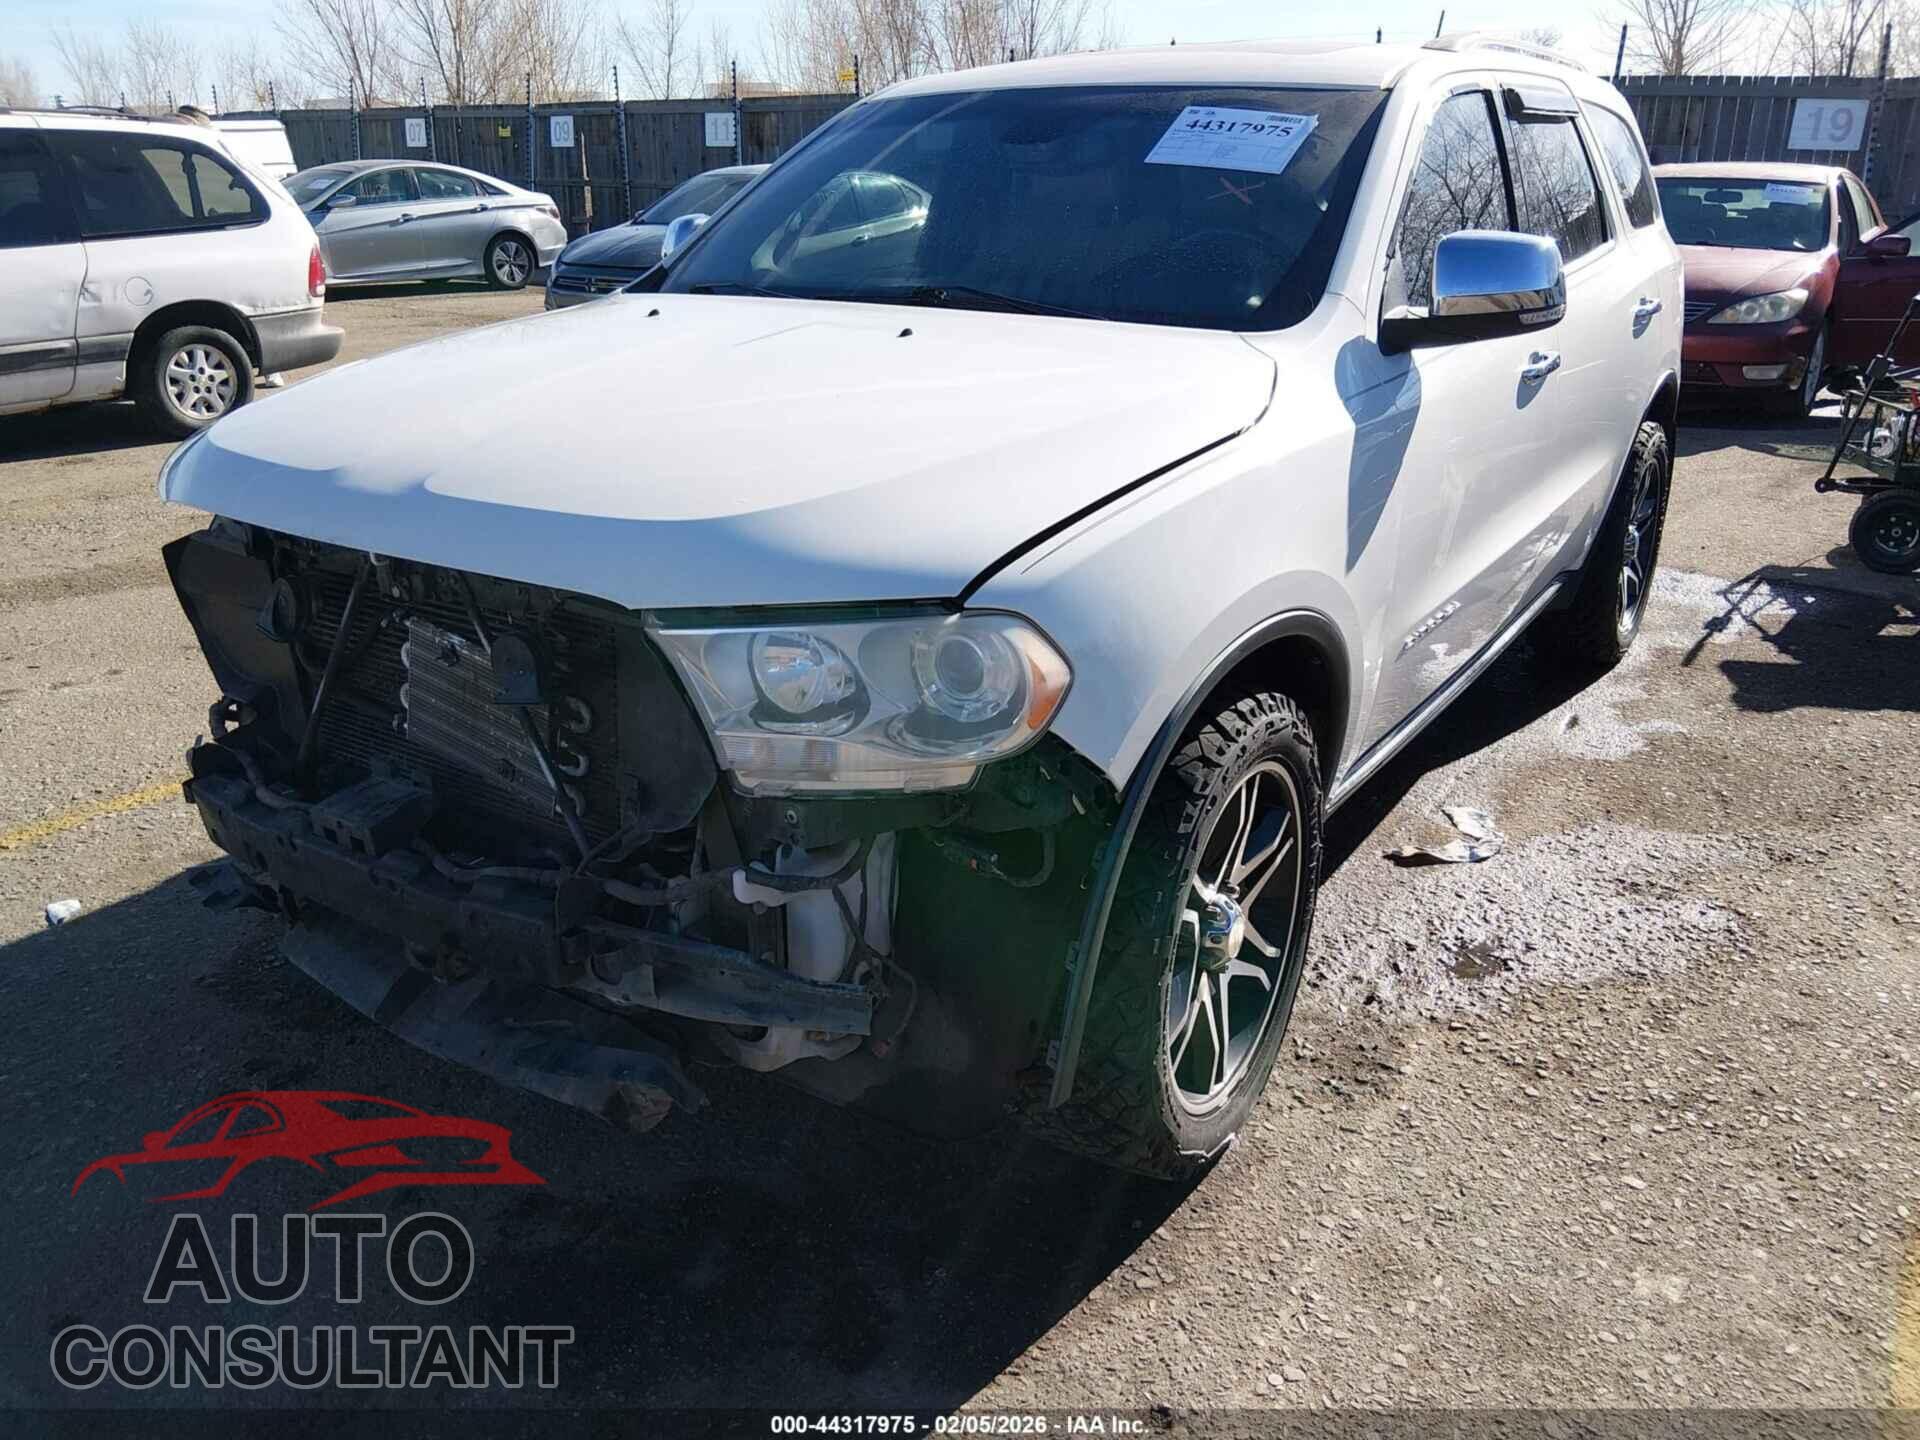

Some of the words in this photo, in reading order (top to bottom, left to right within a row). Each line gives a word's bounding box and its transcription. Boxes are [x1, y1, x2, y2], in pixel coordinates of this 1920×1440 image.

[408, 121, 422, 143] 07
[554, 120, 570, 142] 09
[710, 117, 730, 141] 11
[1186, 119, 1293, 137] 44317975
[1807, 106, 1854, 143] 19
